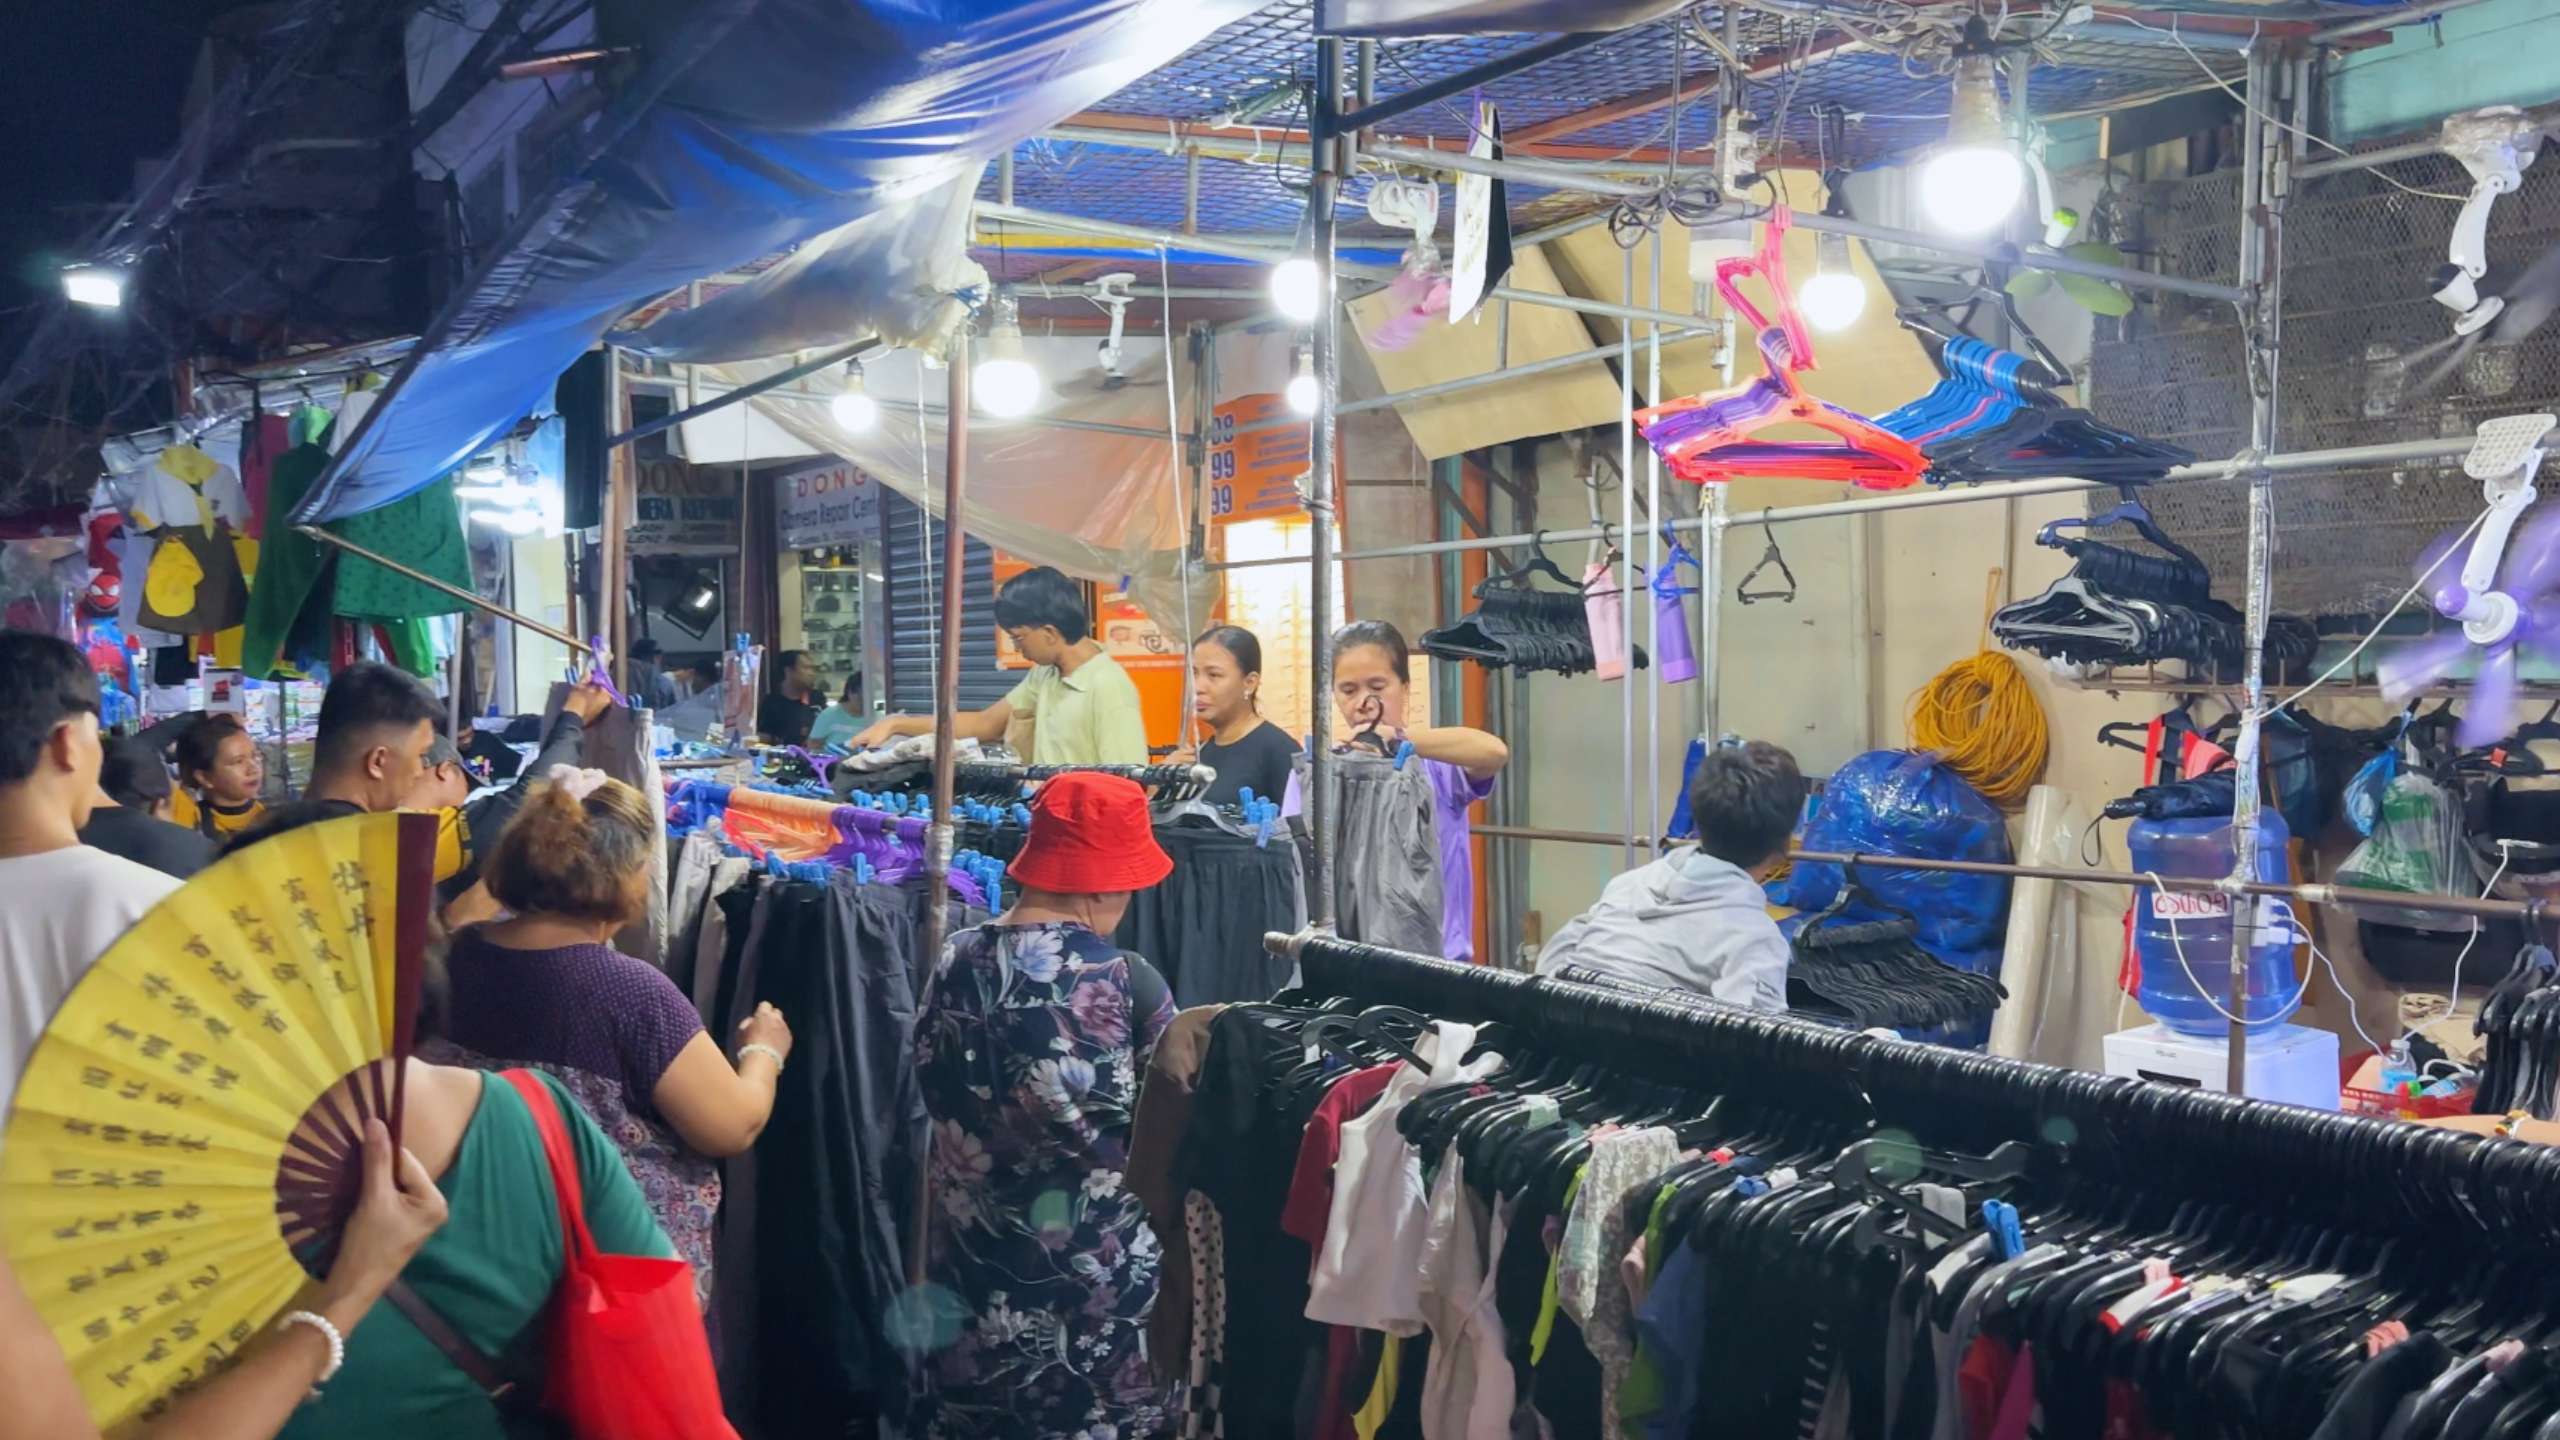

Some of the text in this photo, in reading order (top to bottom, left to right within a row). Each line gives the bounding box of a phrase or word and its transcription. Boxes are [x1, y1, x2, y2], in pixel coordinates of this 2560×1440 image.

[797, 466, 867, 497] DONG
[781, 506, 817, 531] Camera
[820, 501, 851, 524] Repair
